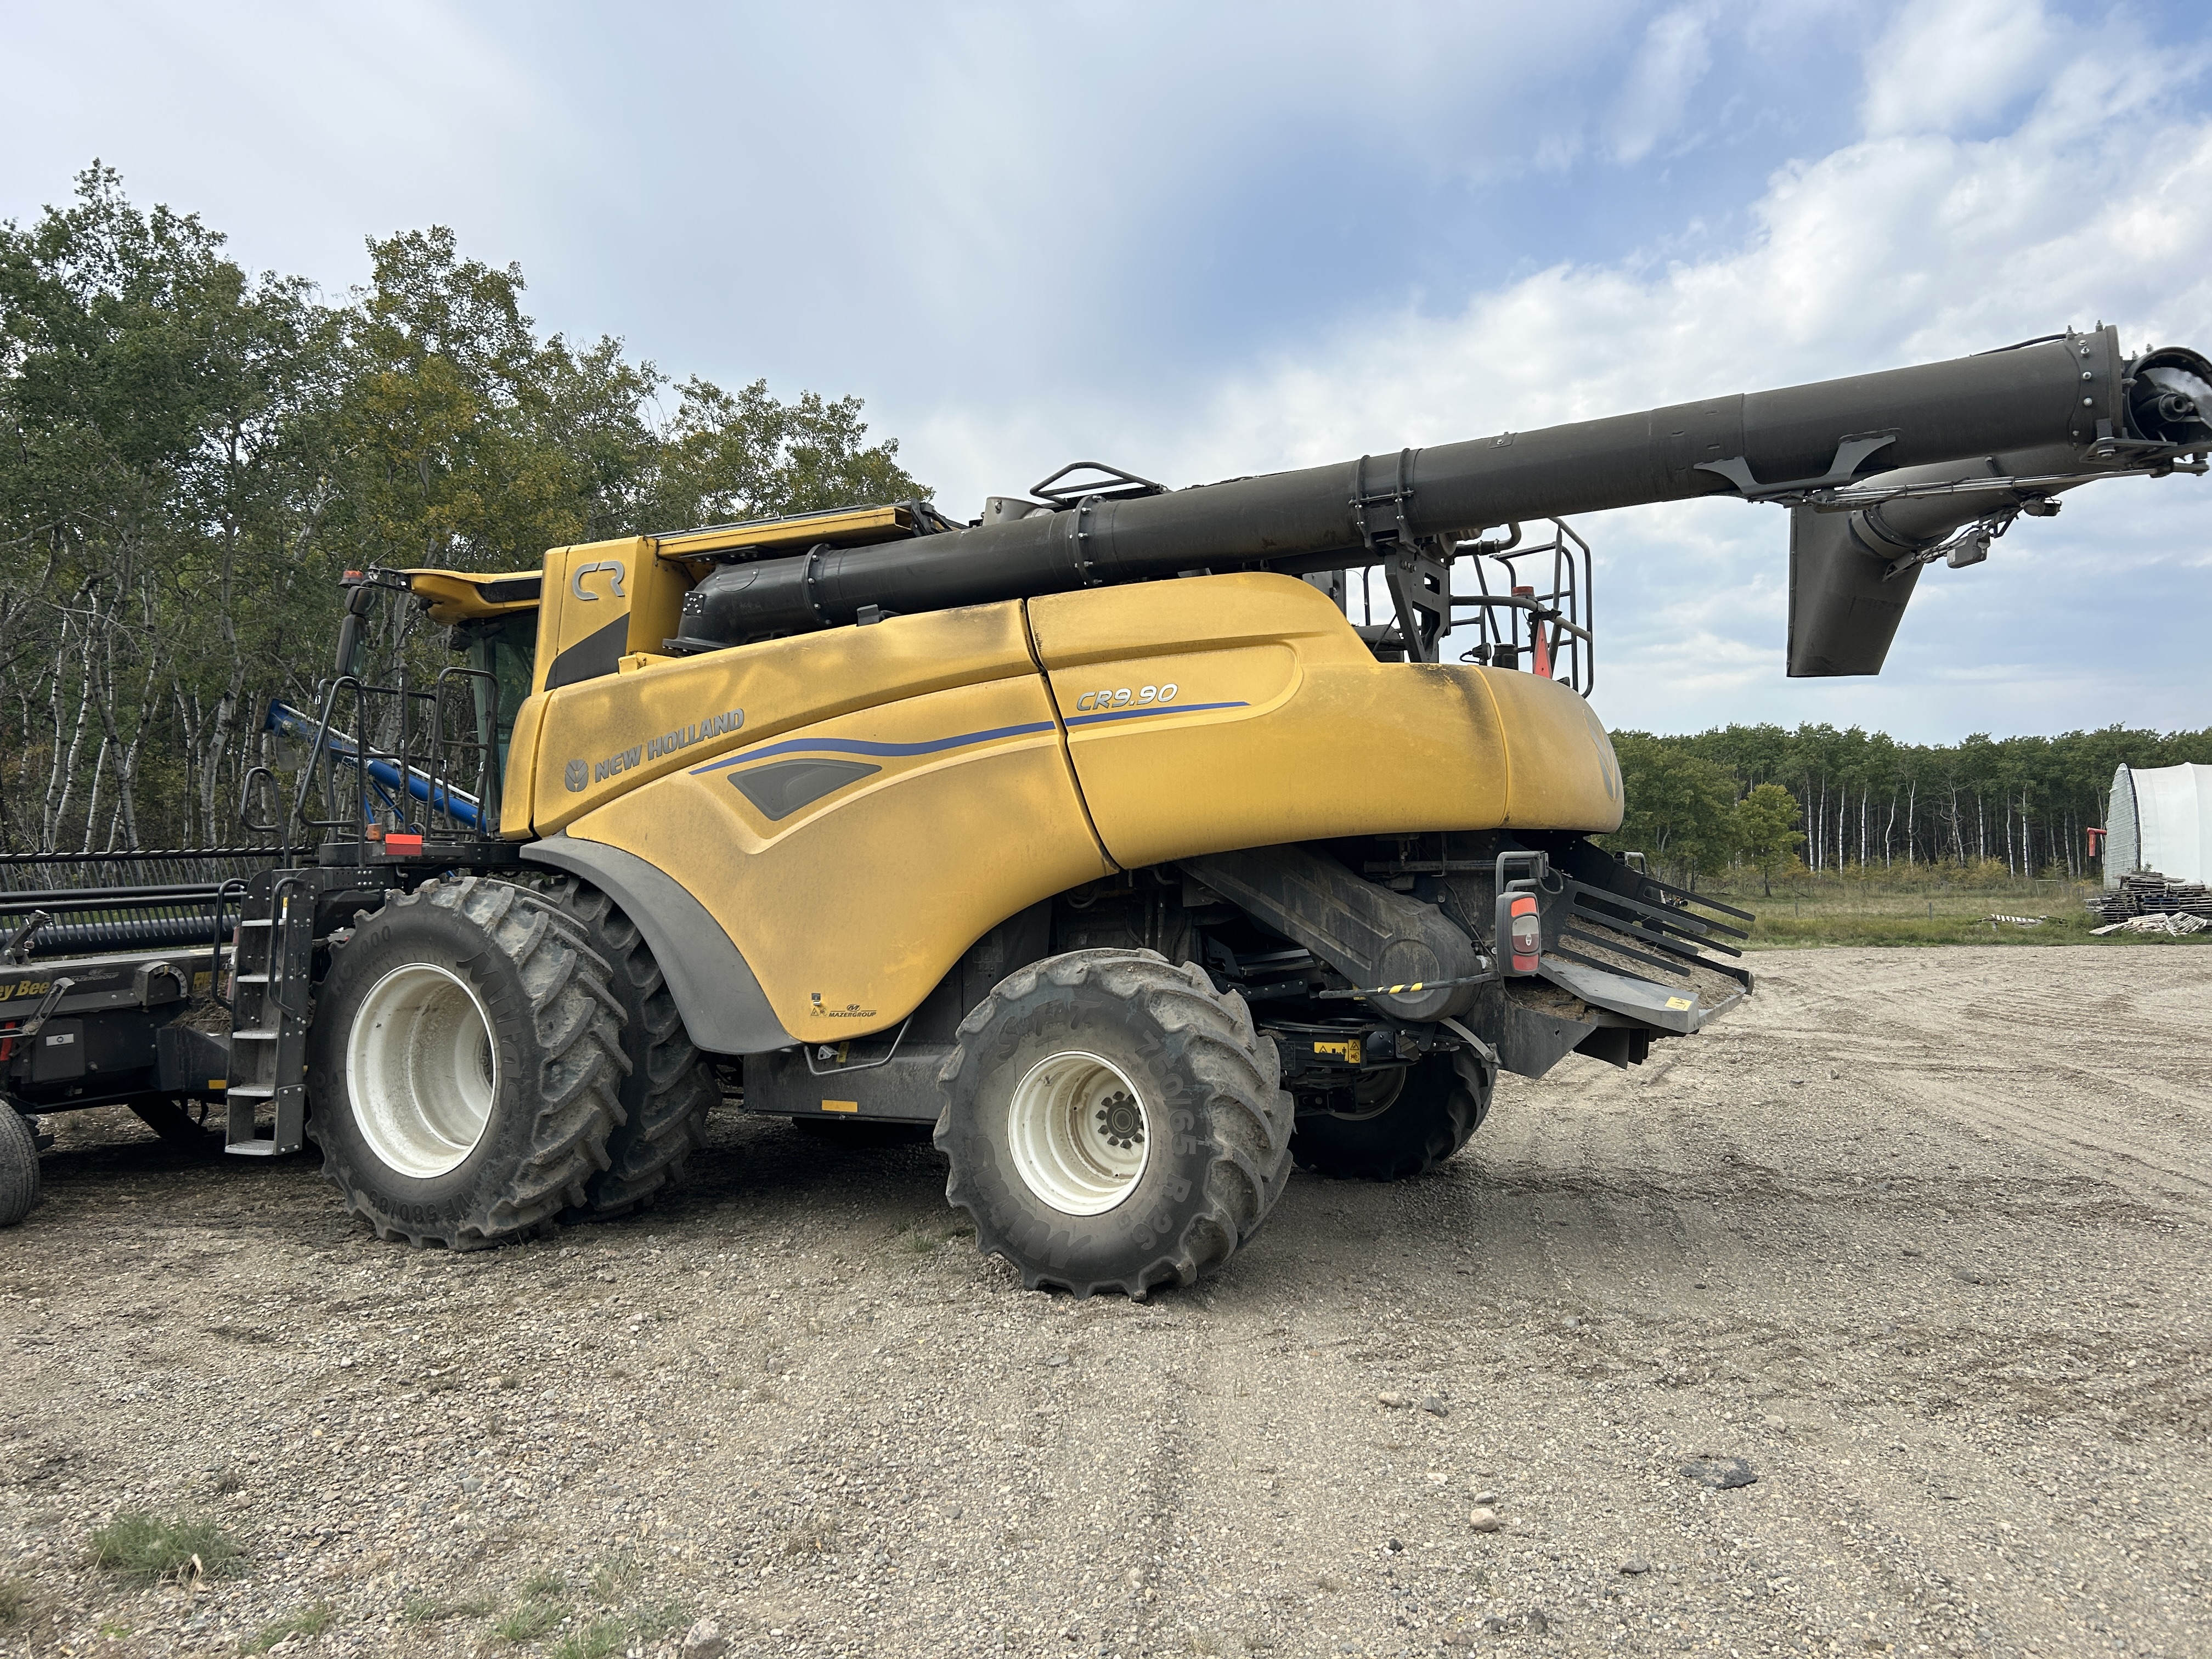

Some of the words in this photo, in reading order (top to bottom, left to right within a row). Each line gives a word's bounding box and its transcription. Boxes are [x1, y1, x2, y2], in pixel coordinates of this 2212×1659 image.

[572, 560, 625, 601] CR
[1076, 684, 1178, 711] CR9.90
[595, 746, 642, 783] NEW
[647, 708, 744, 760] HOLLAND
[14, 980, 50, 996] Bee
[456, 951, 522, 1114] Mitas
[1135, 1030, 1197, 1156] 750/65
[368, 1189, 438, 1224] 580/85
[964, 1135, 1092, 1269] Mitas
[1161, 1173, 1193, 1203] R
[1132, 1205, 1173, 1251] 26
